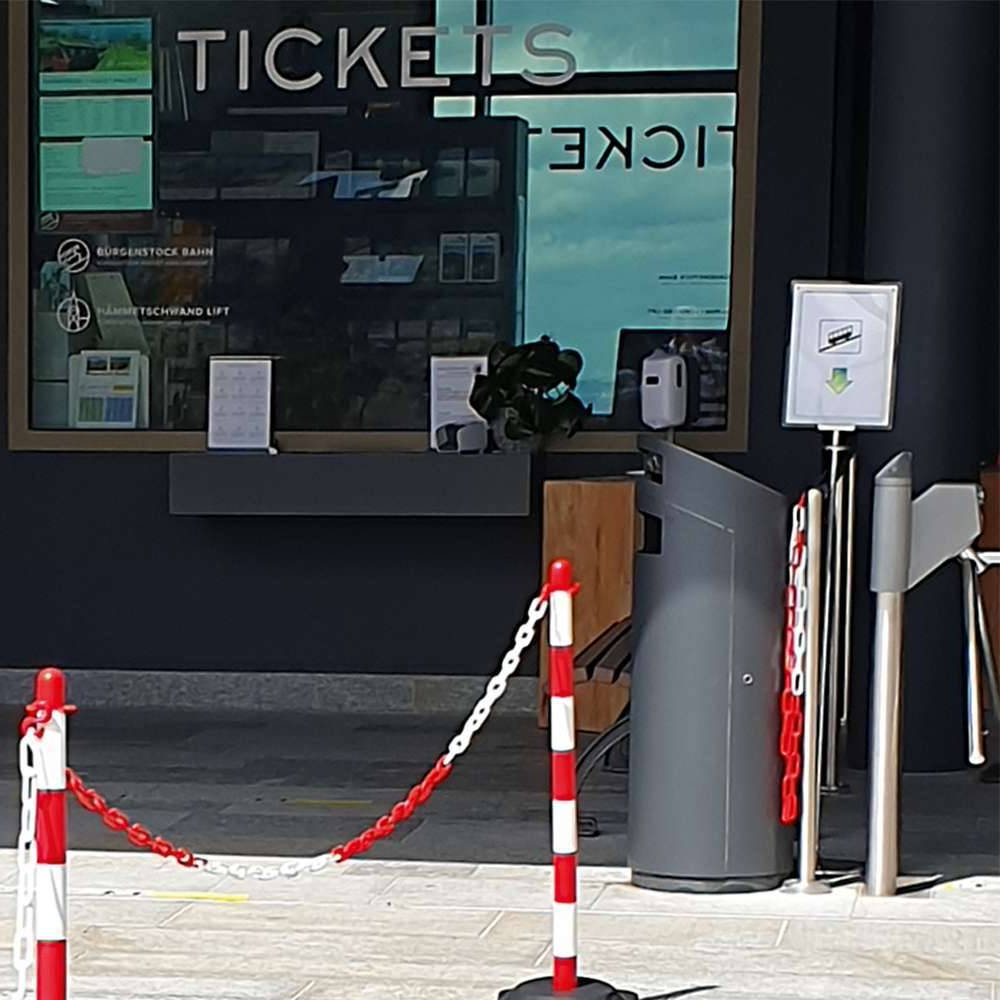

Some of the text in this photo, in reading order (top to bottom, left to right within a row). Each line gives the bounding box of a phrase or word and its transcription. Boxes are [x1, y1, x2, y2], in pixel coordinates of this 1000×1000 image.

[178, 22, 577, 91] TICKETS
[182, 247, 213, 257] BAHN
[206, 306, 230, 317] LIFT
